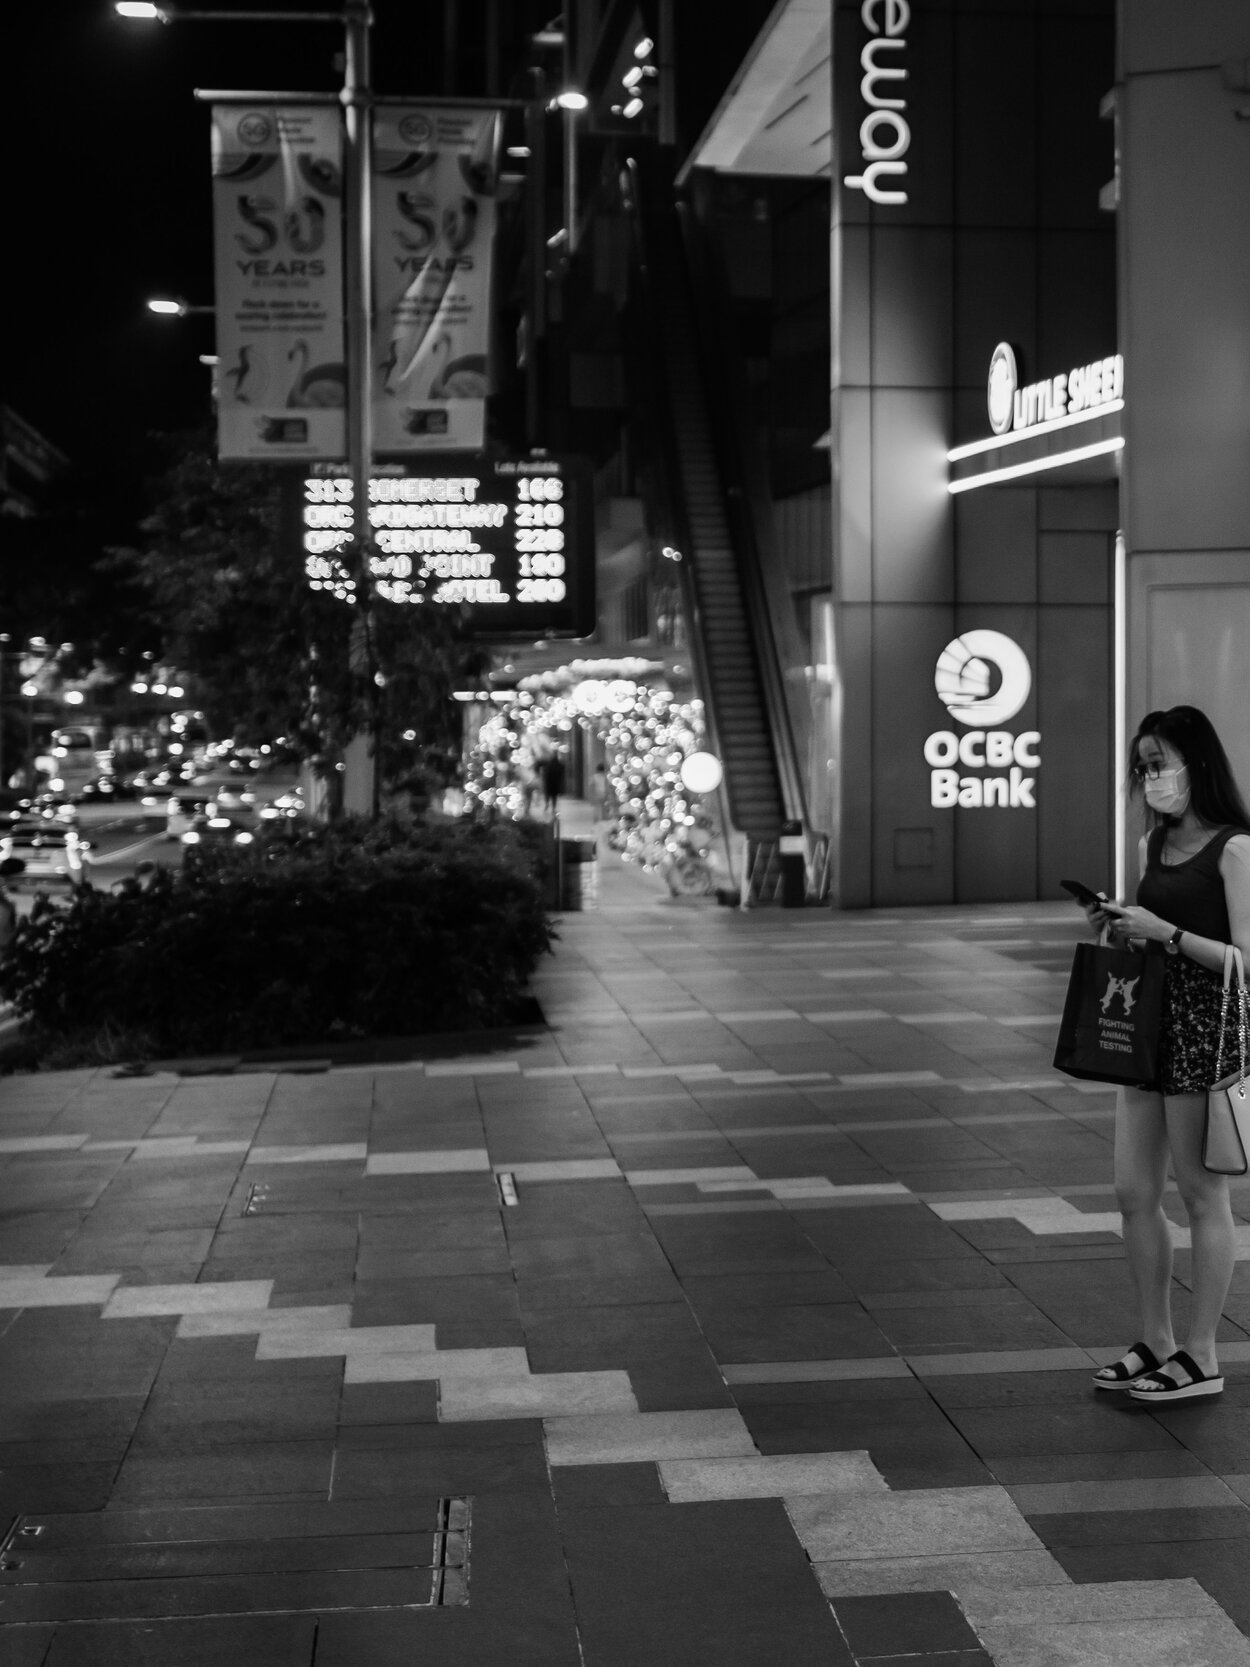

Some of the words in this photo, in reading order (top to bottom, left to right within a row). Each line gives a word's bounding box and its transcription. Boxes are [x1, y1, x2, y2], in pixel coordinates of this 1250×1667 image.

[235, 258, 326, 277] YEARS
[1013, 373, 1068, 430] LITTLE
[304, 479, 354, 502] 313
[515, 503, 564, 527] 210
[923, 730, 1042, 768] OCBC
[930, 766, 1037, 808] Bank
[1098, 1017, 1135, 1032] FIGHTING
[1100, 1029, 1131, 1042] ANIMAL
[1098, 1039, 1133, 1054] TESTING
